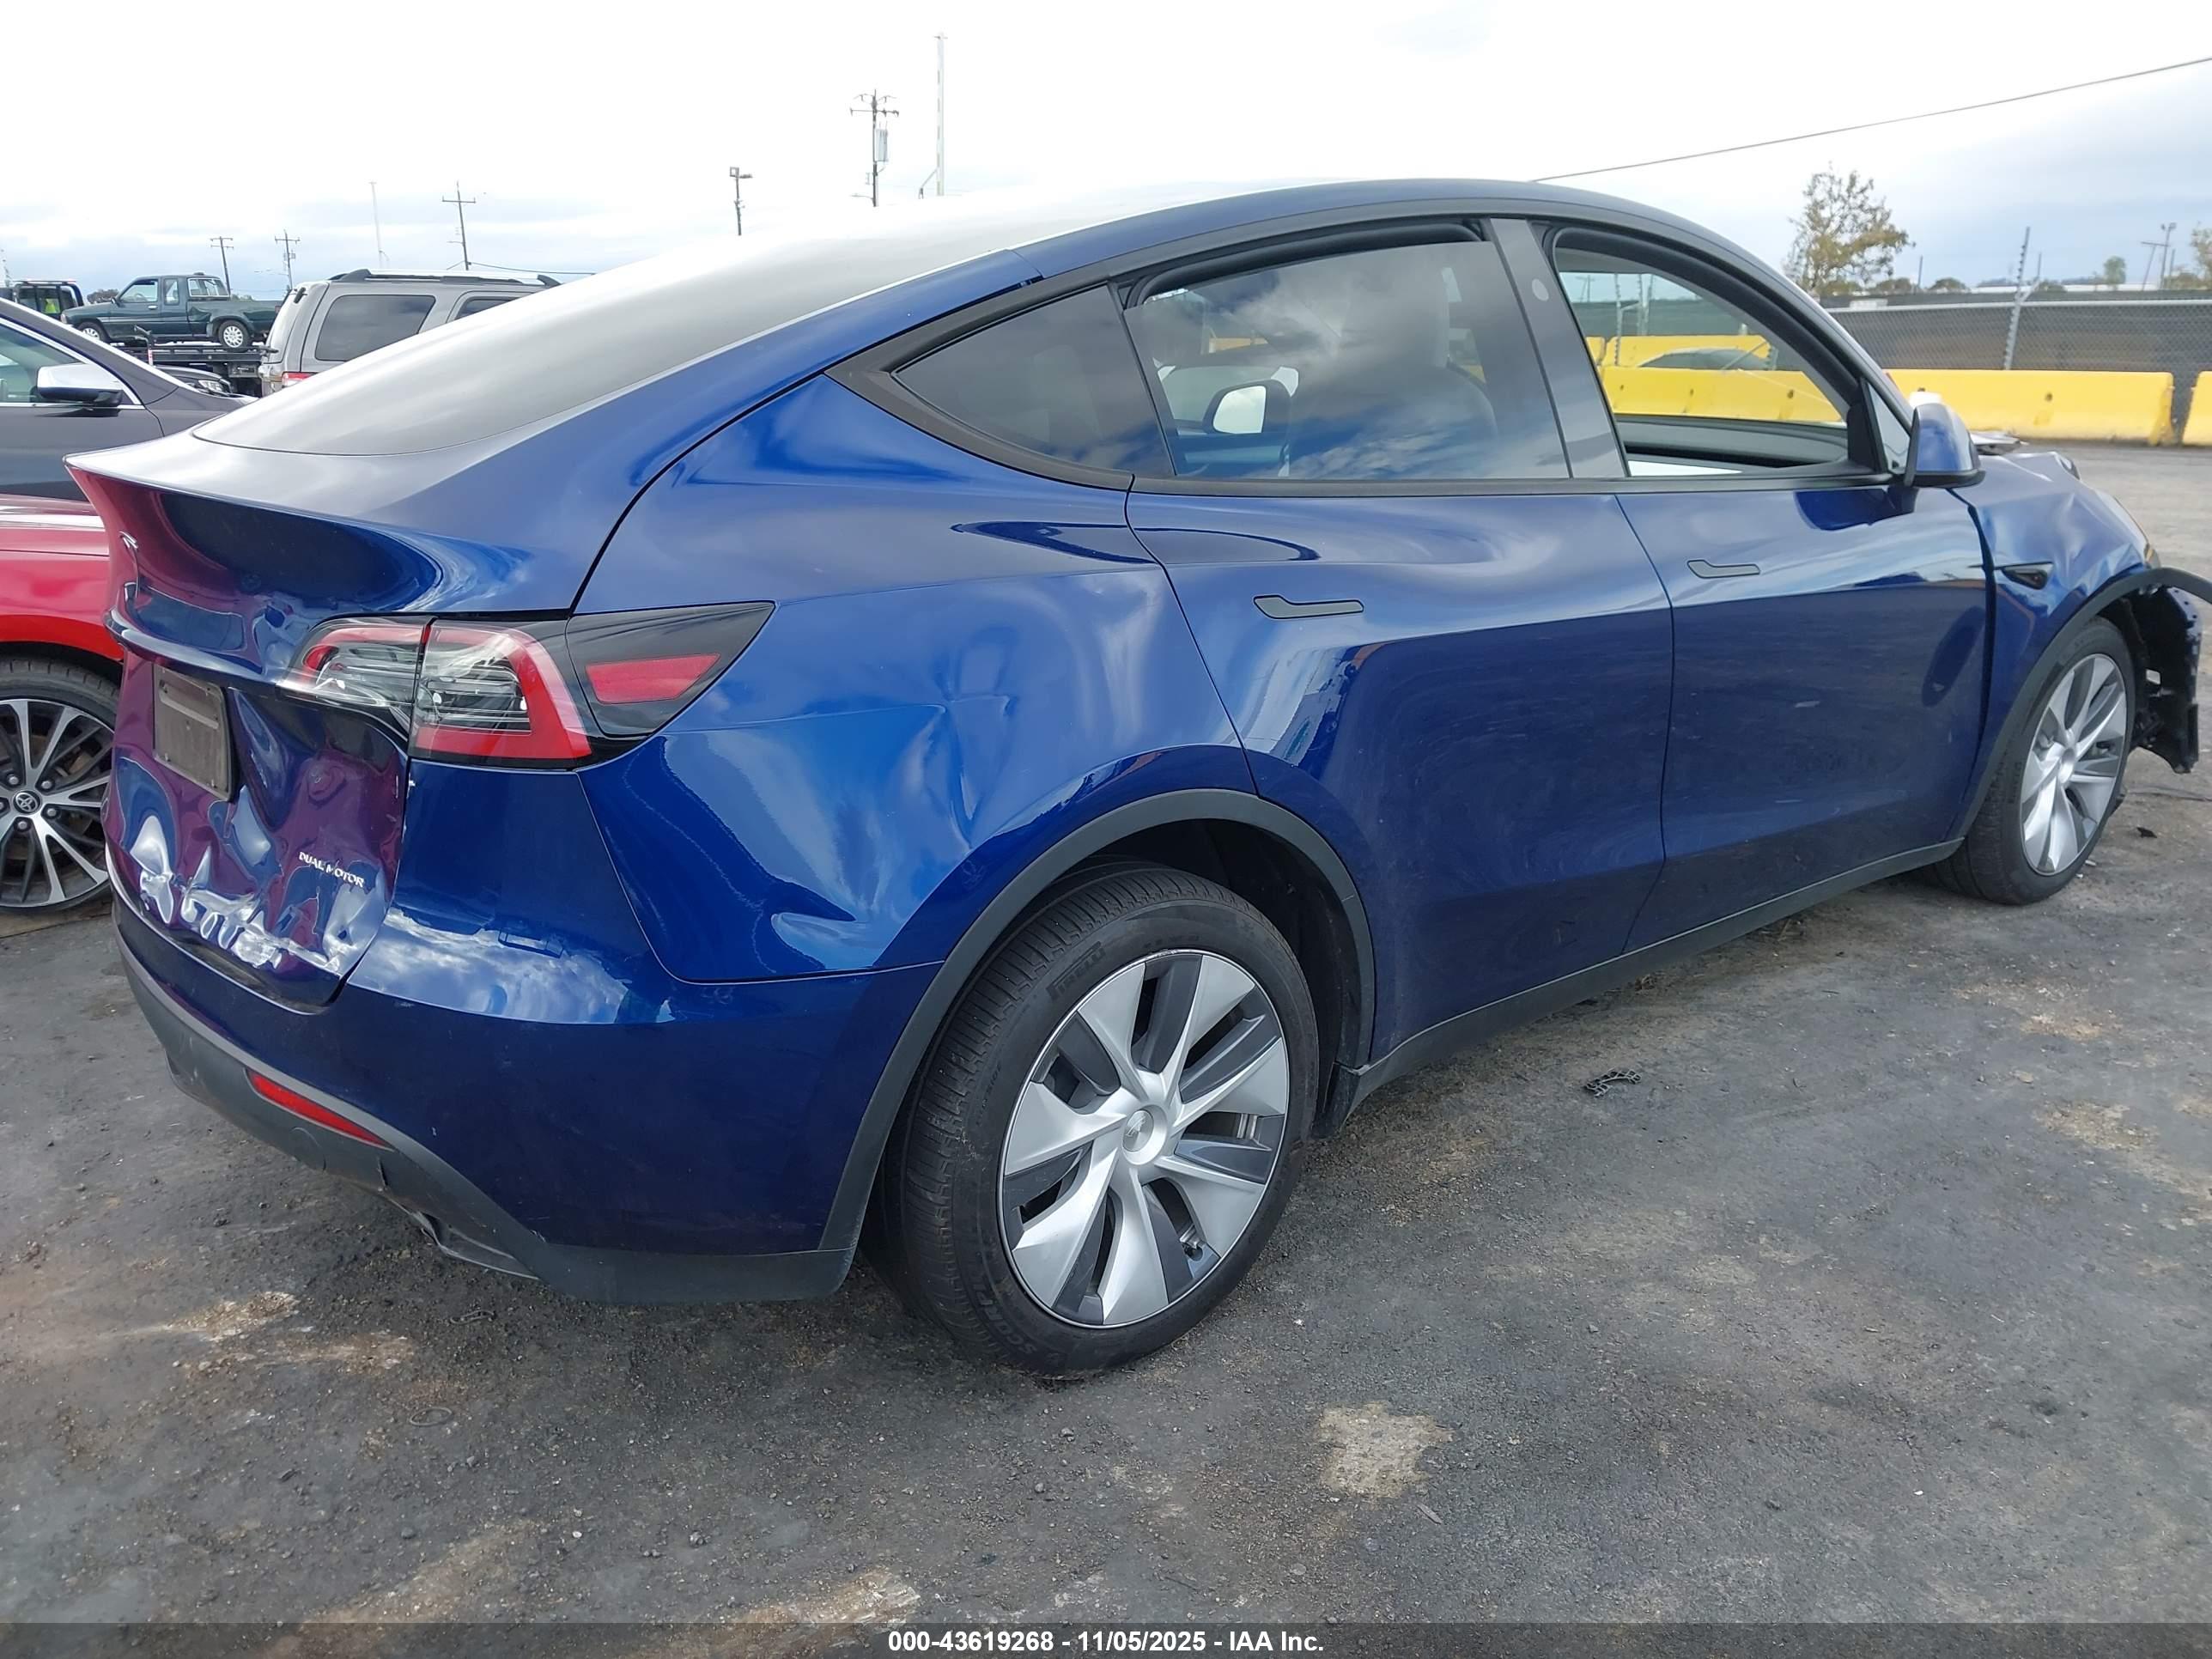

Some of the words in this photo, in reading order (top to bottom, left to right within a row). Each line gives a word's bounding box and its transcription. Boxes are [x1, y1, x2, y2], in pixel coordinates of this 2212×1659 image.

[299, 851, 324, 872] DUAL
[325, 861, 364, 888] MOTOR
[1046, 941, 1106, 1000] PIRELLI
